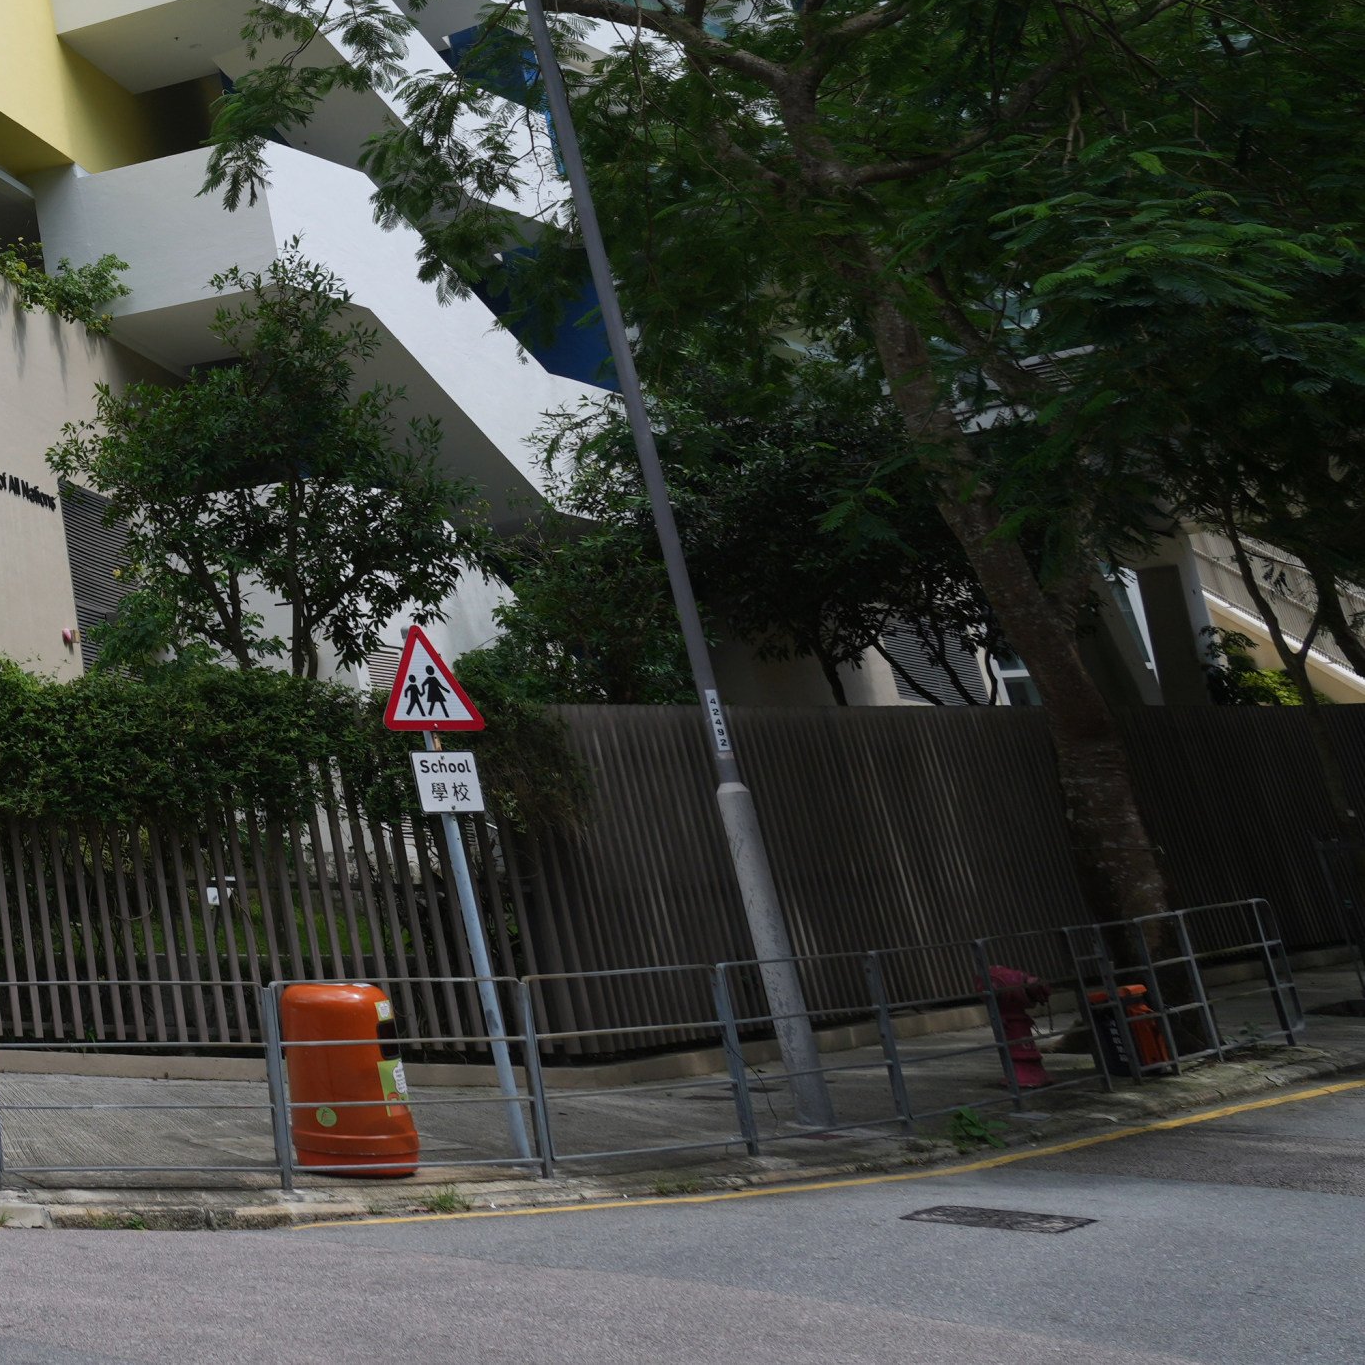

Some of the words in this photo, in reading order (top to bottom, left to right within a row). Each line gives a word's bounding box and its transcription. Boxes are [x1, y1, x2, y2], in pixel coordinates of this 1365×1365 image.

[9, 475, 21, 497] All
[21, 480, 56, 512] Nations
[710, 698, 728, 746] 42492
[420, 759, 472, 773] School
[431, 782, 471, 802] 學校
